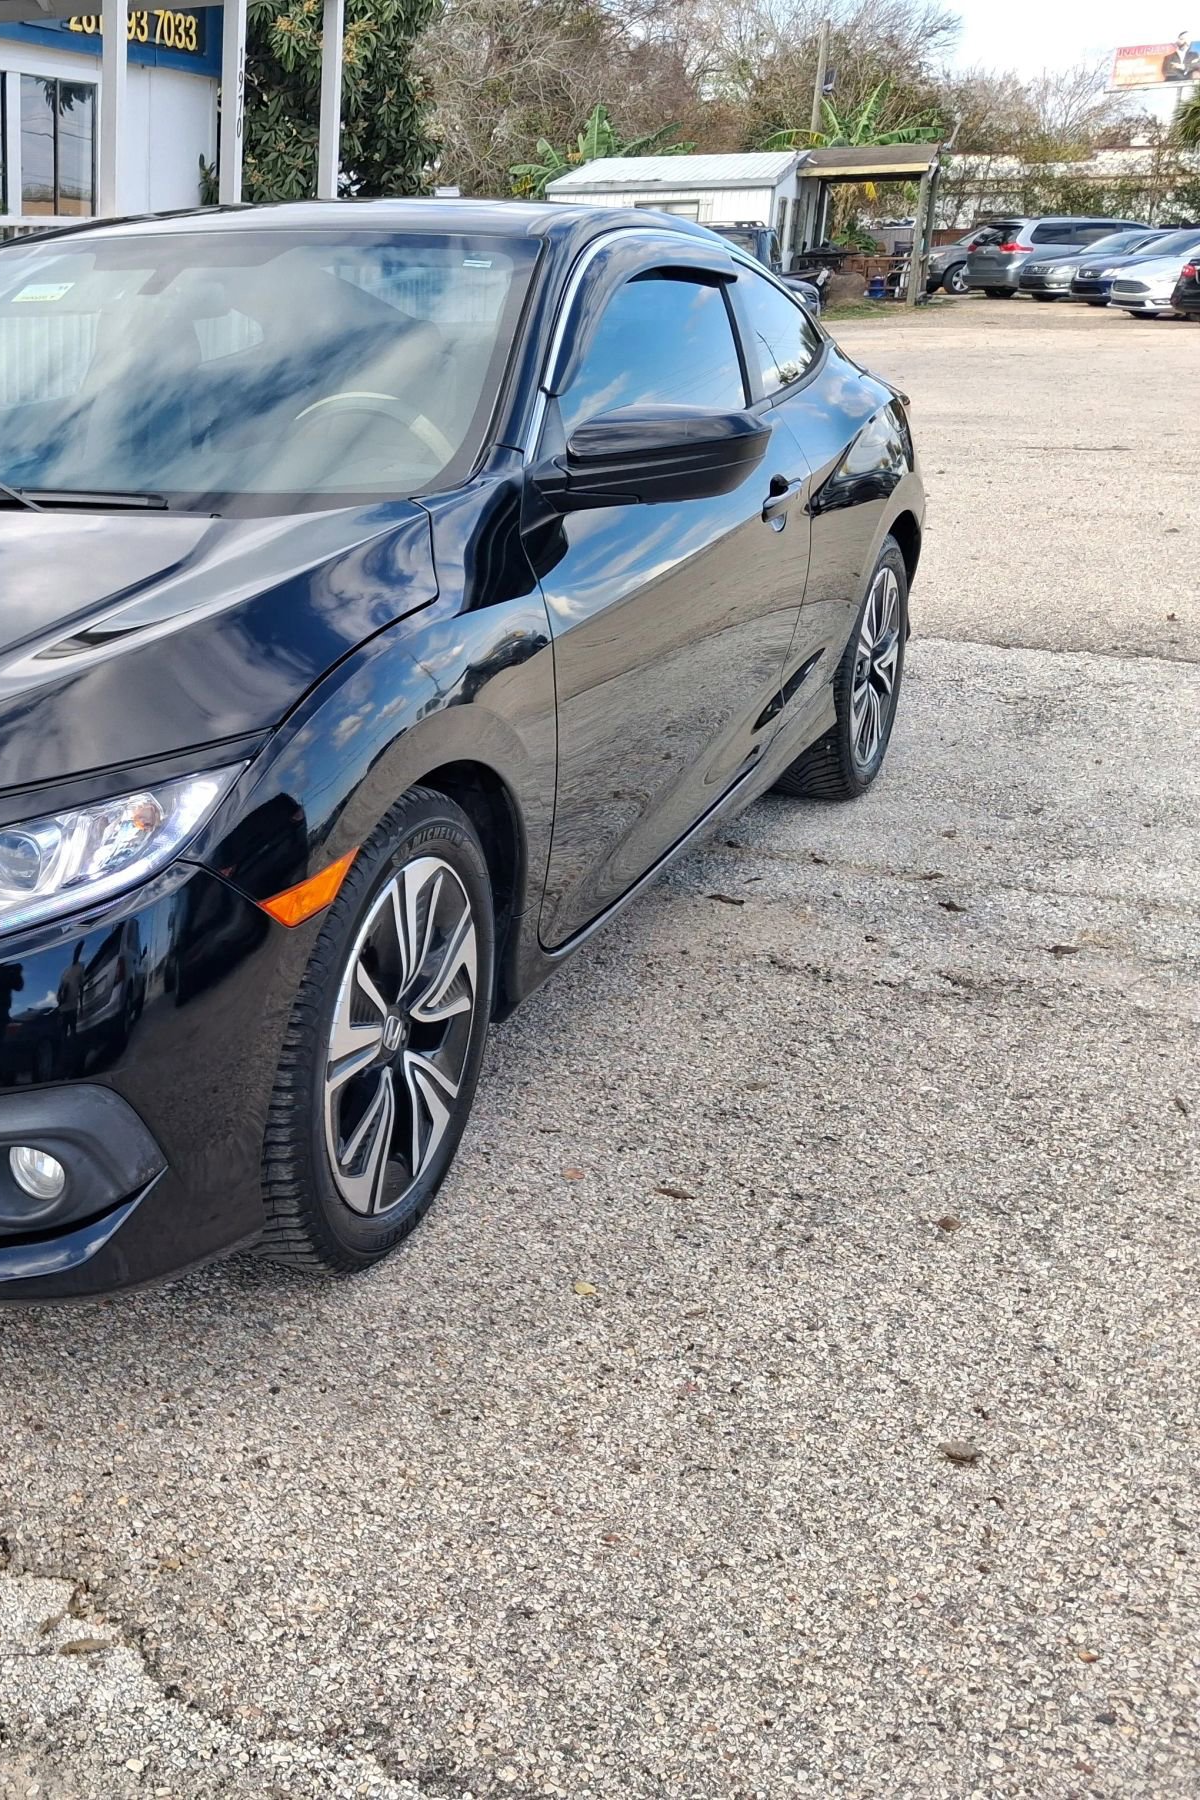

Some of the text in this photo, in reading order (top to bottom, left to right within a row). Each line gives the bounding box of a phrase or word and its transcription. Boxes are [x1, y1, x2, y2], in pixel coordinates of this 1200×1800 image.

[154, 9, 197, 51] 7033
[236, 46, 244, 138] 1970
[412, 826, 463, 848] MICHELIN
